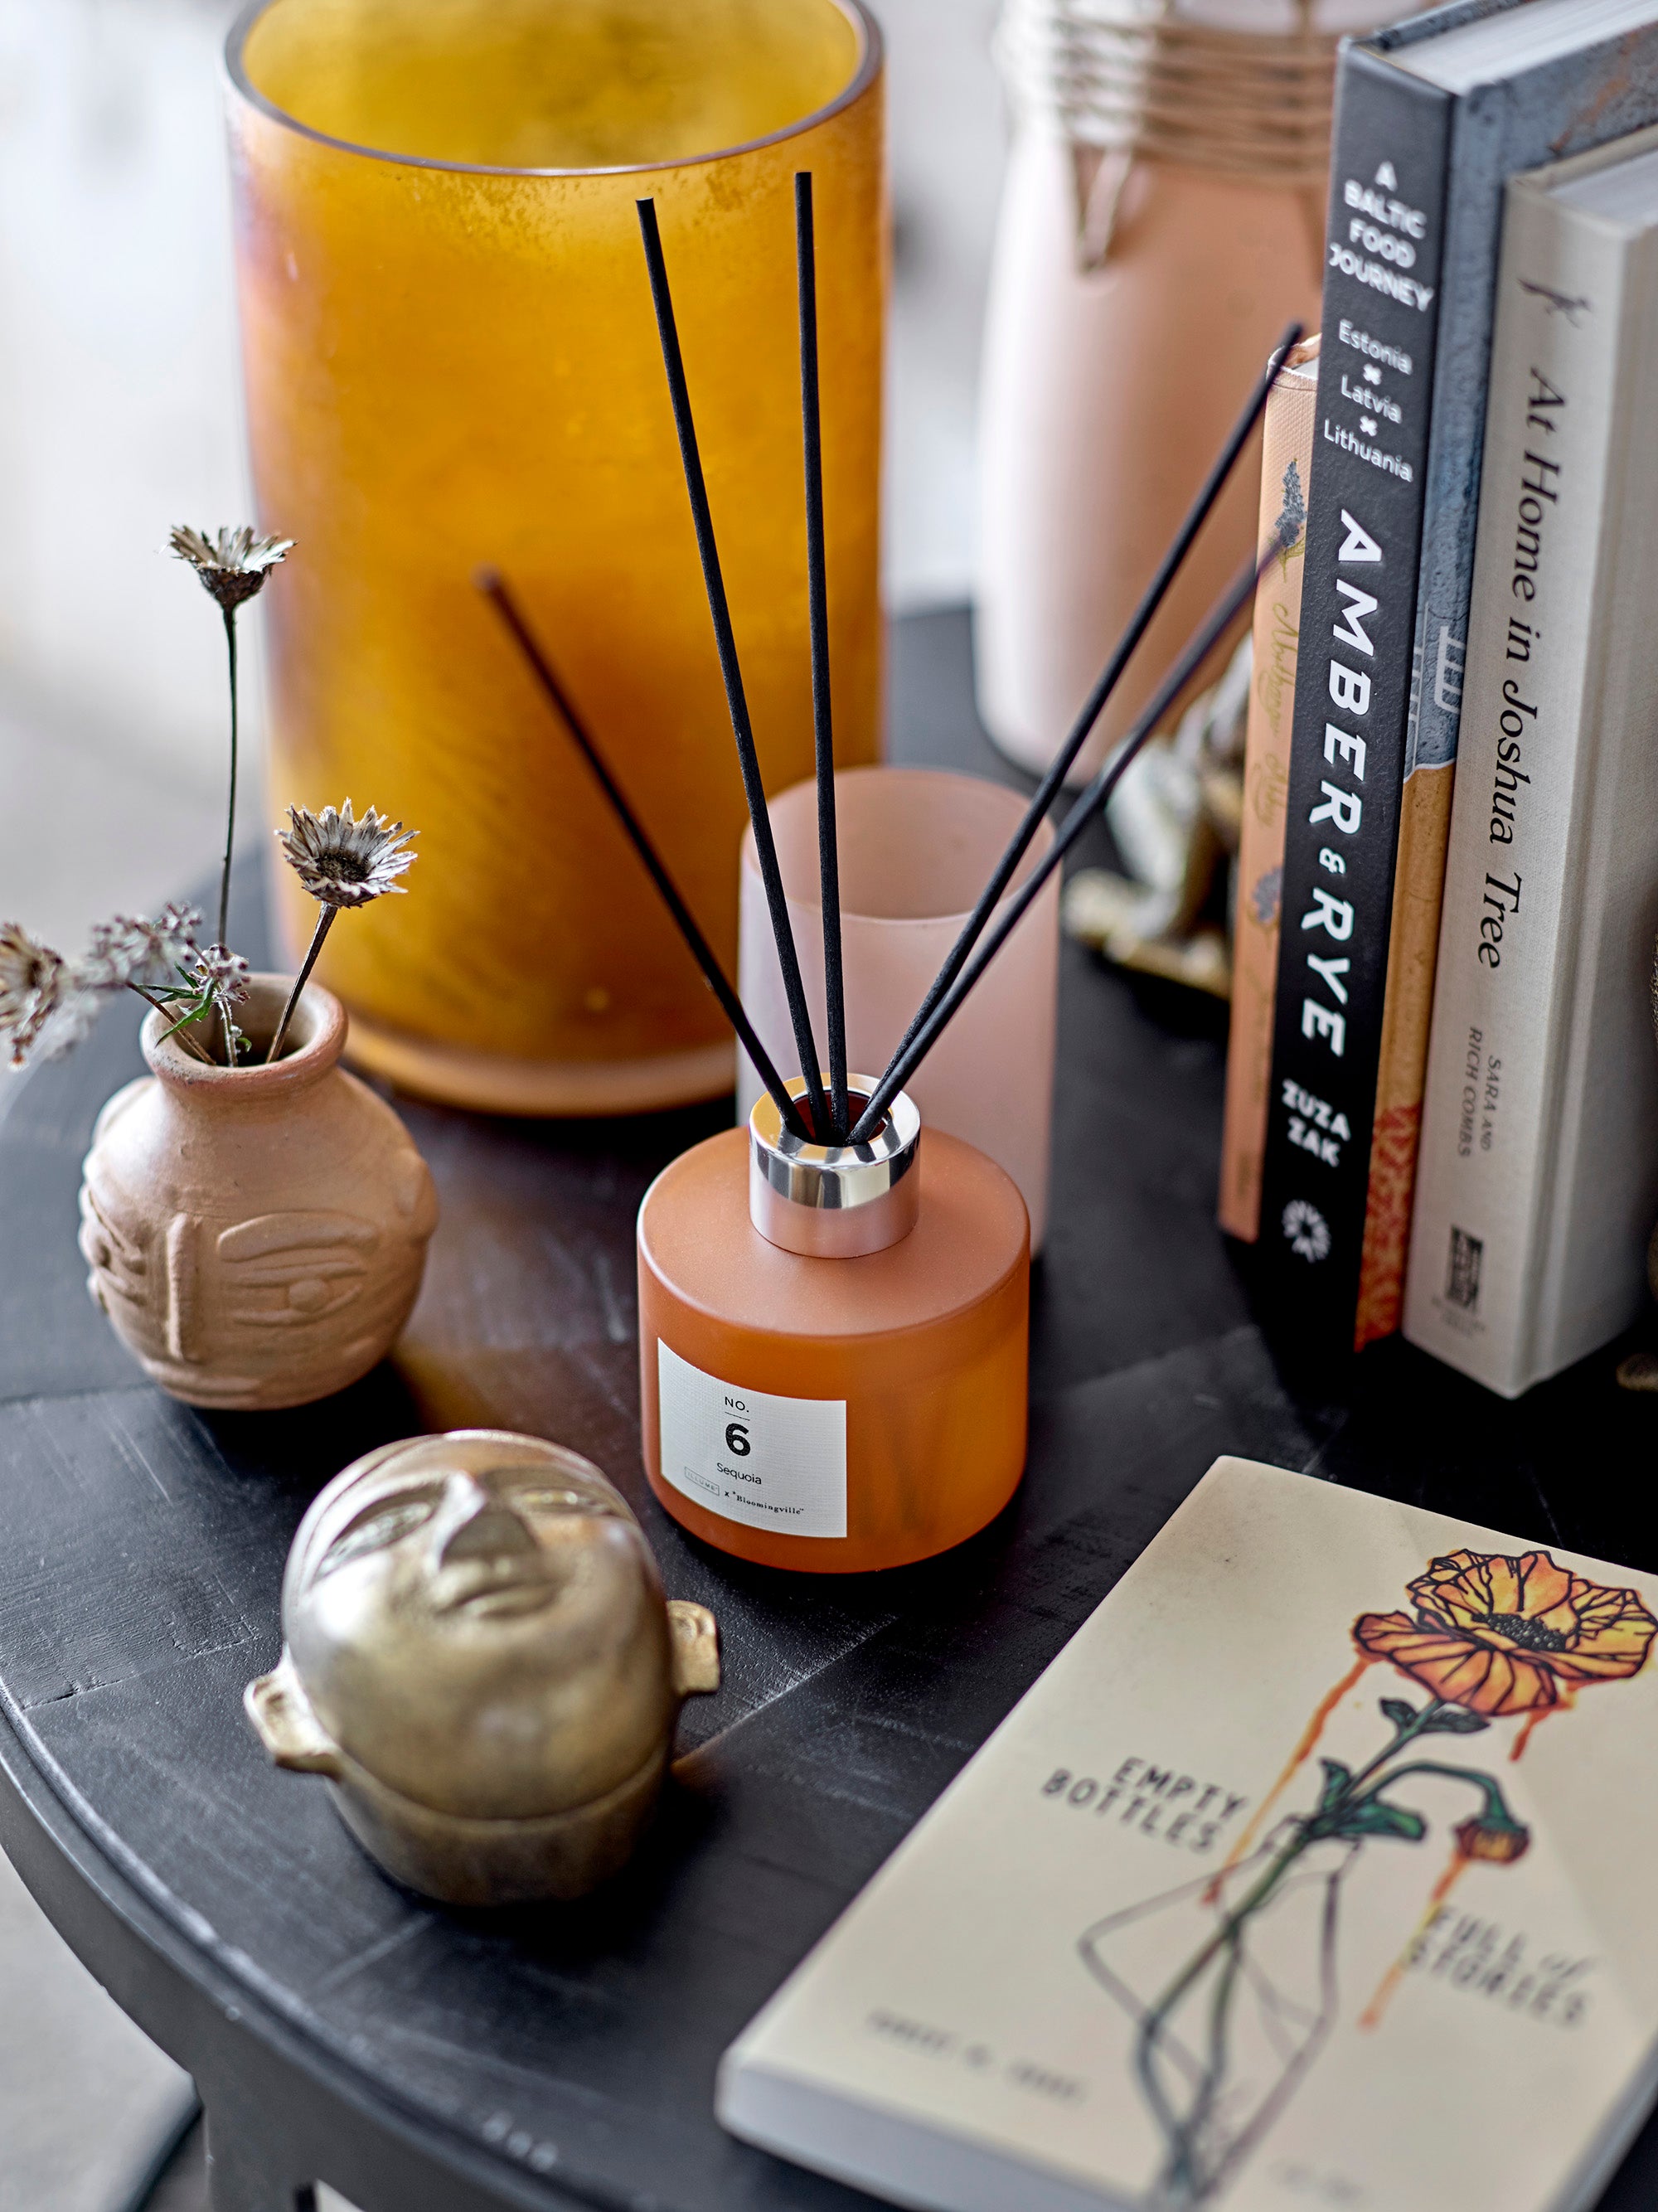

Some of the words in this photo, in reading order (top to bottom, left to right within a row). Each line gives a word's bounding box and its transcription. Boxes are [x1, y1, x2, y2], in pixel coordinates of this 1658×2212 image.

[1374, 161, 1399, 192] A
[1344, 179, 1428, 240] BALTIC
[1348, 217, 1416, 269] FOOD
[1328, 242, 1434, 312] JOURNEY
[1339, 319, 1413, 376] Estonia
[1340, 374, 1403, 424] Latvia
[1526, 366, 1566, 435] At
[1324, 419, 1413, 483] Lithuania
[1512, 449, 1561, 603] Home
[1506, 615, 1541, 662] in
[1309, 508, 1382, 835] AMBER
[1490, 679, 1538, 845] Joshua
[1318, 847, 1345, 875] &
[1478, 872, 1522, 968] Tree
[1300, 887, 1355, 1057] RYE
[1464, 1026, 1482, 1083] RICH
[1483, 1055, 1501, 1113] SARA
[1282, 1079, 1351, 1142] ZUZA
[1457, 1085, 1478, 1157] COMBS
[1480, 1116, 1494, 1152] AND
[1287, 1118, 1340, 1167] ZAK
[725, 1396, 749, 1413] NO.
[725, 1423, 751, 1457] 6
[716, 1463, 762, 1485] Sequoia
[1040, 1767, 1224, 1855] BOTTLES
[1110, 1755, 1249, 1820] EMPTY
